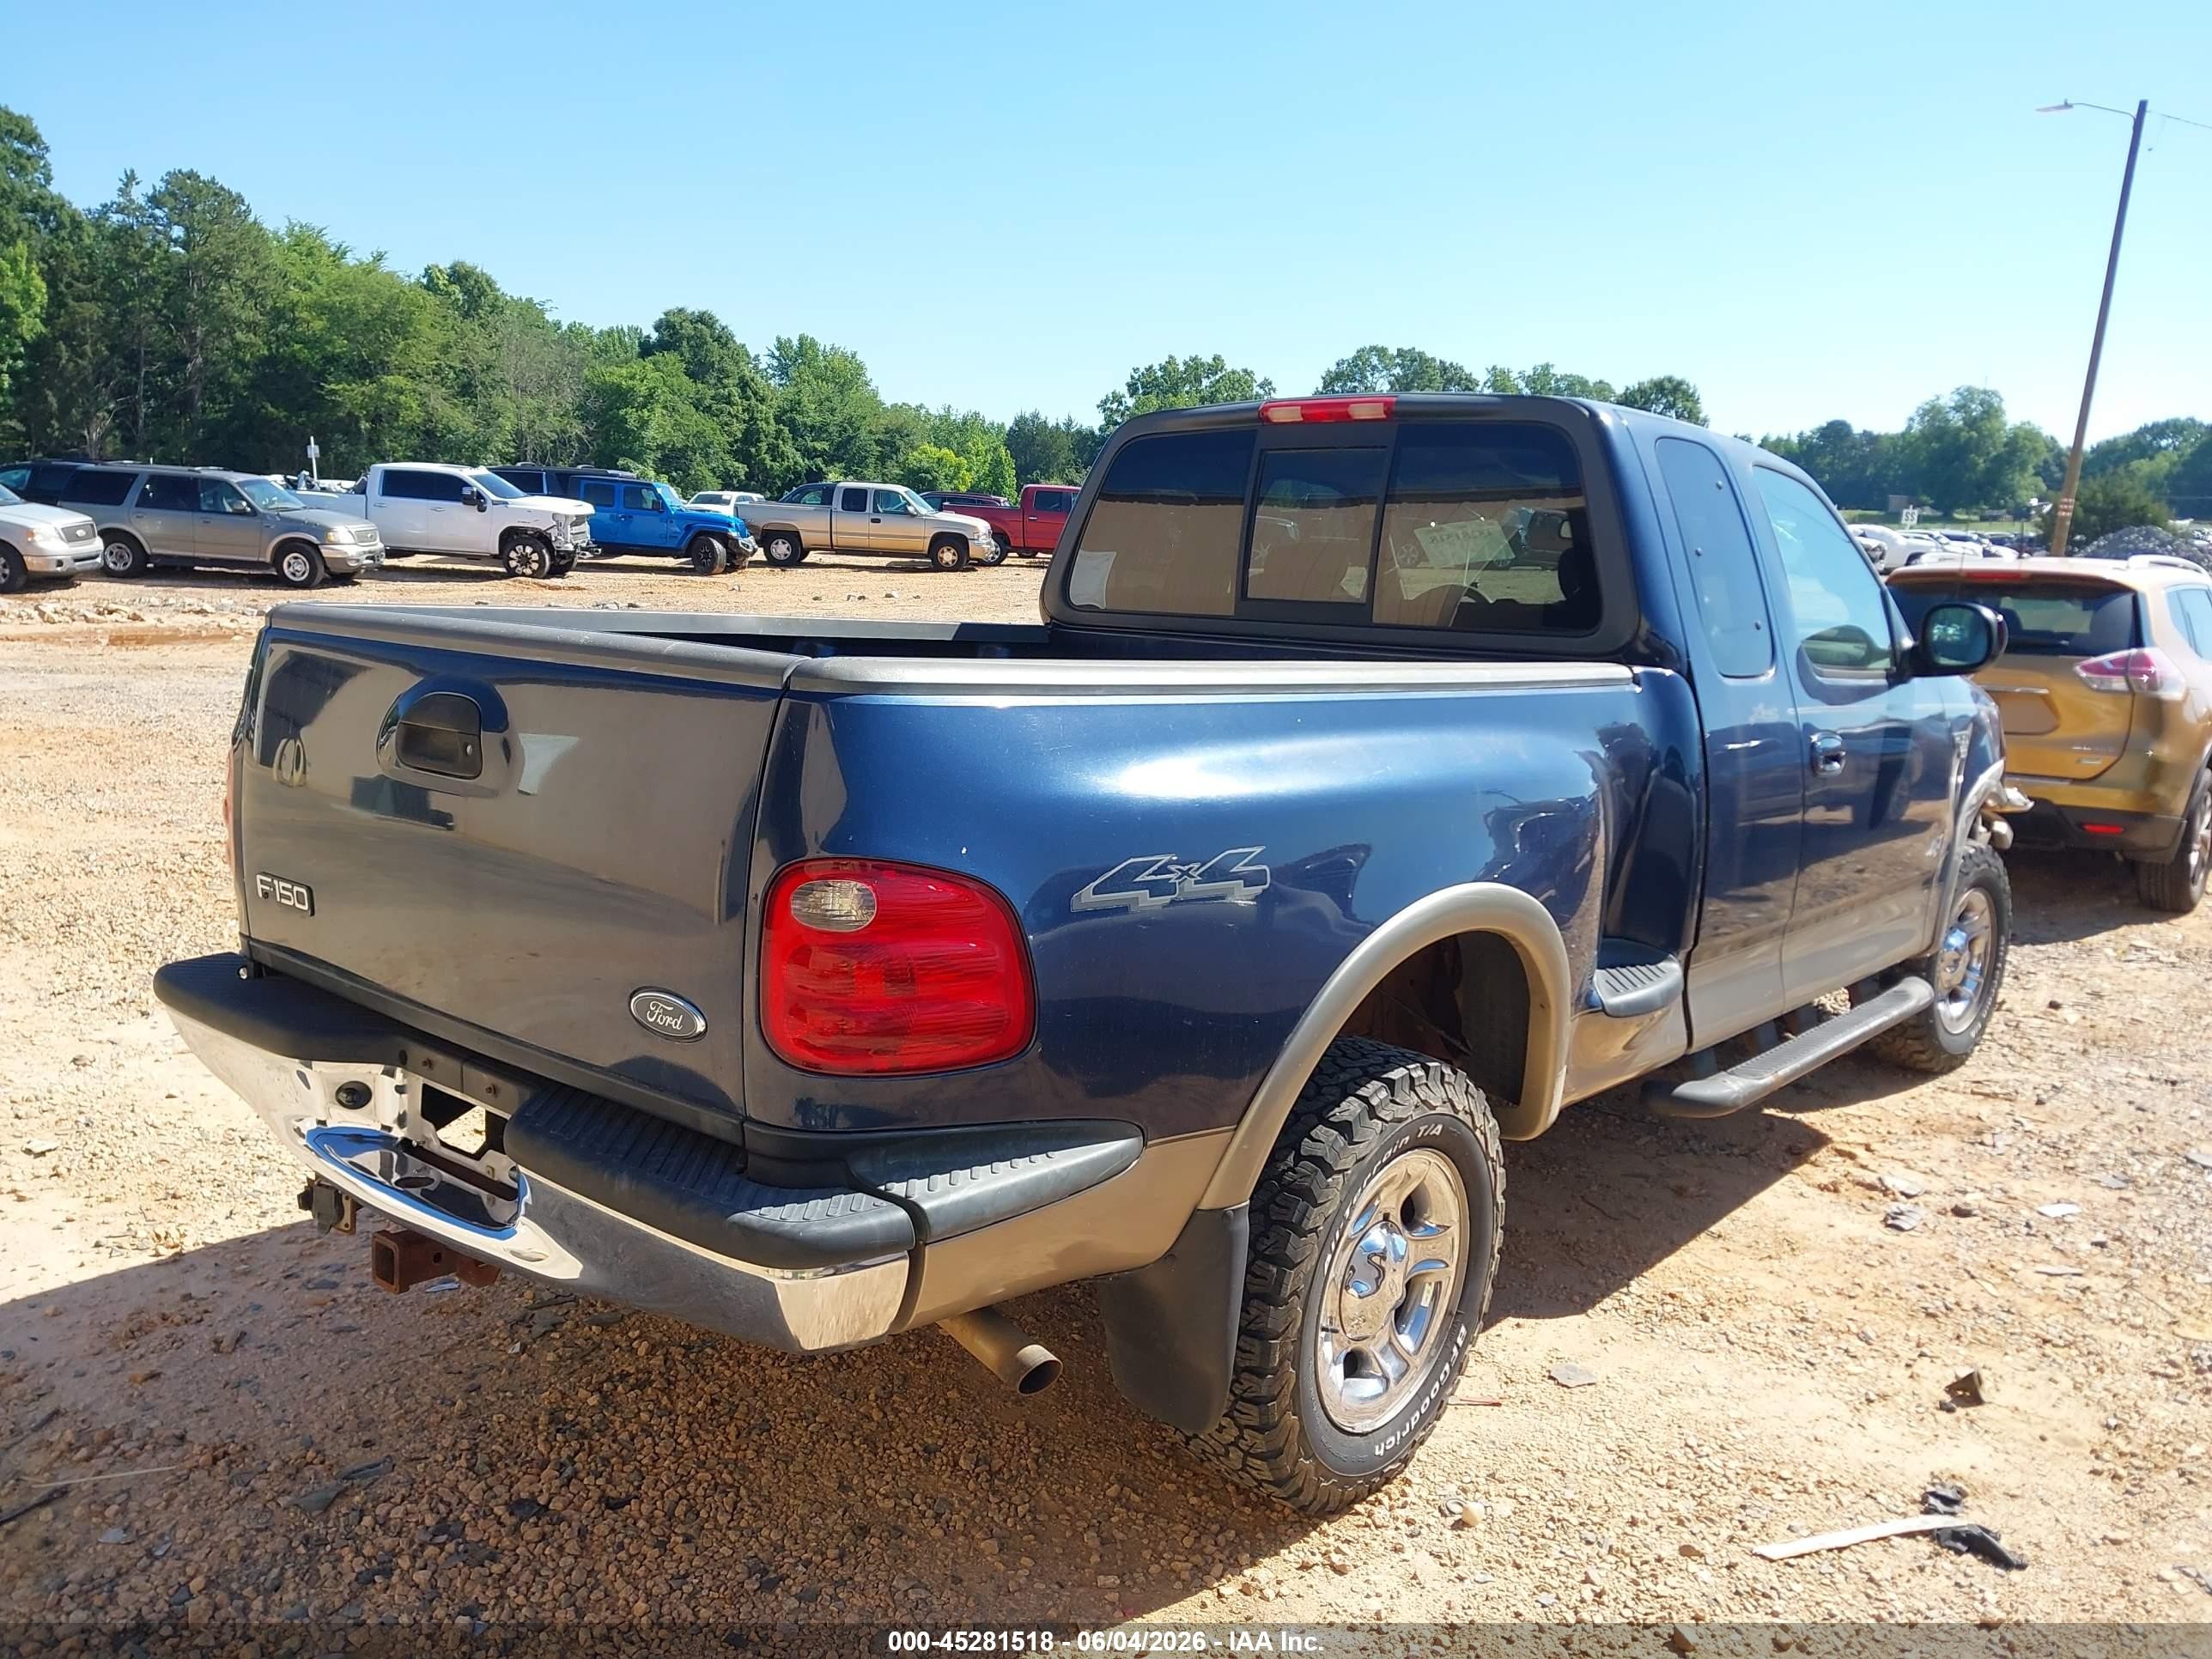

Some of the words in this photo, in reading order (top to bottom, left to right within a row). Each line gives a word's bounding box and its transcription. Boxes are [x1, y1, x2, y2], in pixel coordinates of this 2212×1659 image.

[1071, 846, 1271, 913] 4x4
[647, 1000, 684, 1030] Ford
[1417, 1123, 1444, 1138] T/A
[1375, 1323, 1468, 1456] BFGoodrich
